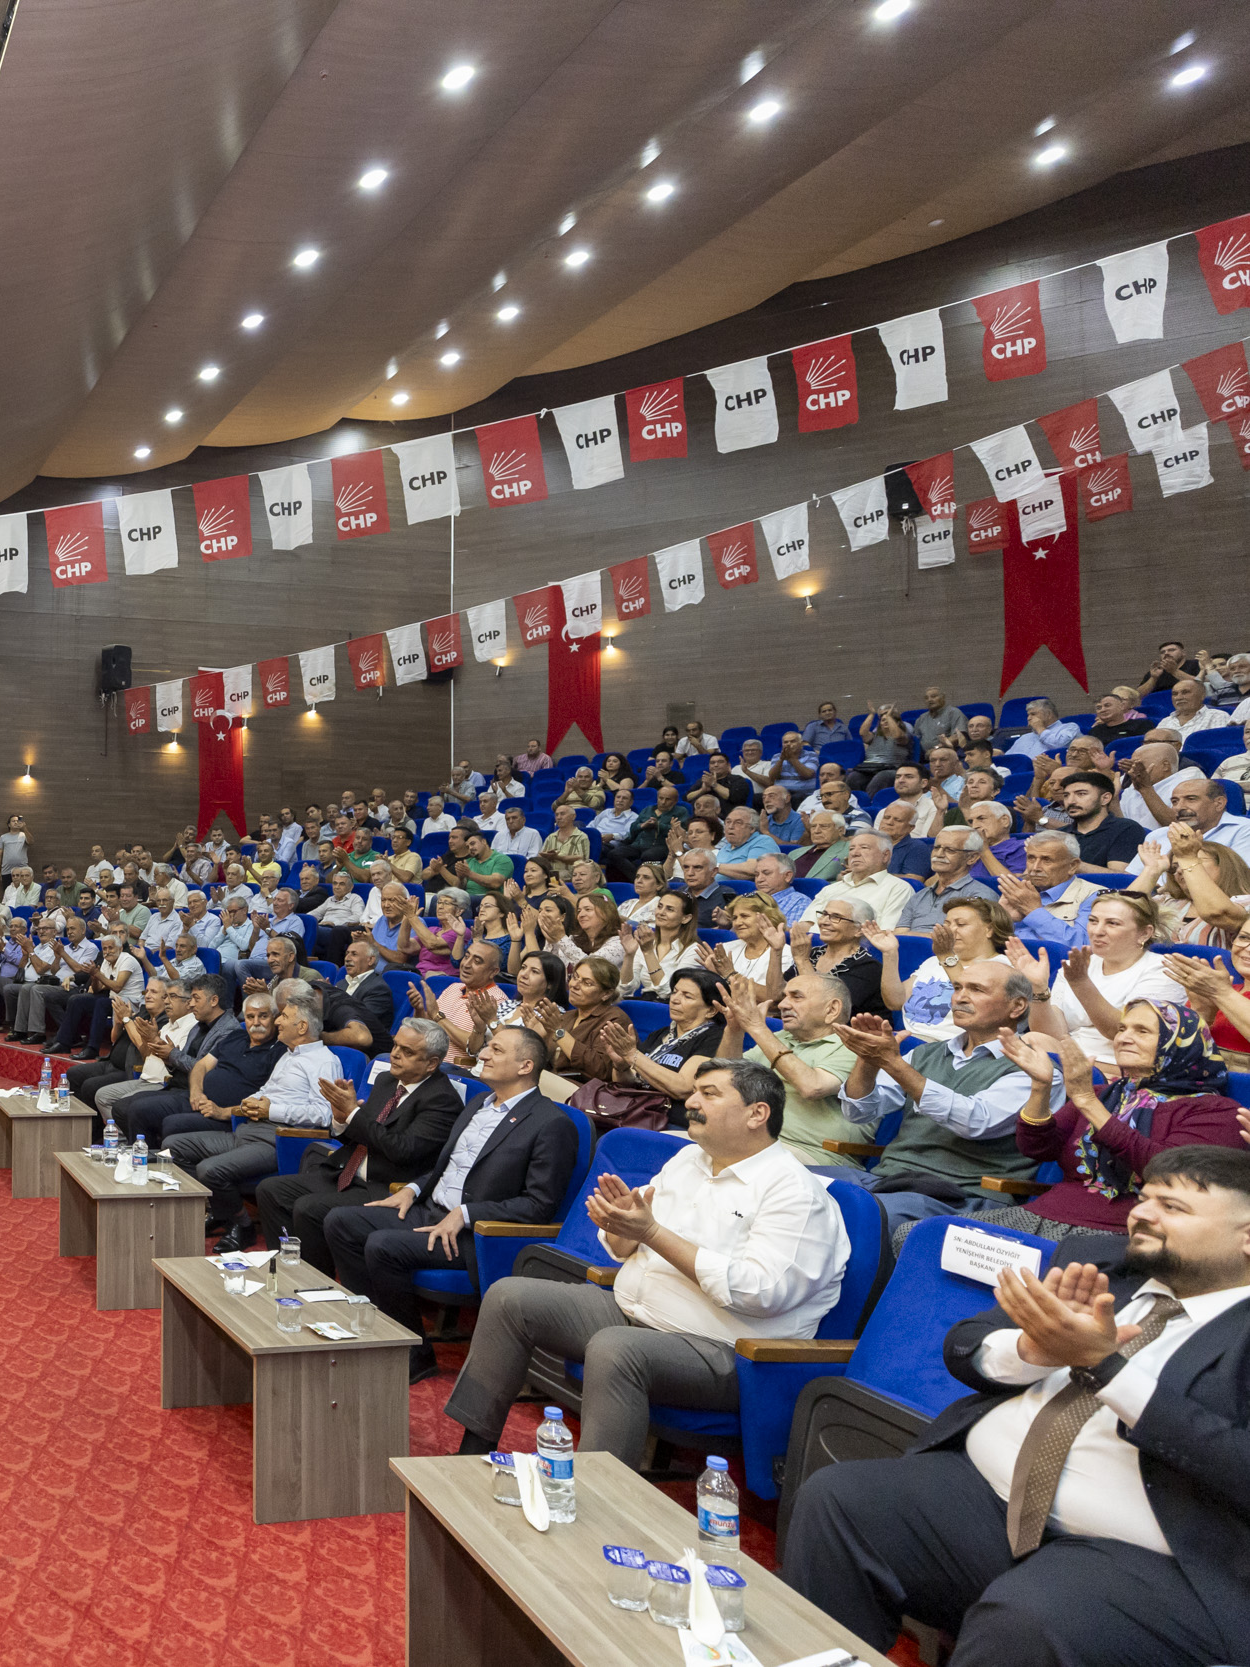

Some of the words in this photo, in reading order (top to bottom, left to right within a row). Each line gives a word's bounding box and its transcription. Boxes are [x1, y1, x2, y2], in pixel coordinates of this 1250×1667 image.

[1222, 268, 1250, 290] CH
[1115, 277, 1157, 301] CHP
[899, 345, 936, 366] CHP
[990, 337, 1037, 360] CHP
[724, 388, 767, 411] CHP
[805, 389, 851, 411] CHP
[1137, 408, 1178, 429] CHP
[575, 428, 612, 450] CHP
[641, 422, 683, 441] CHP
[1074, 450, 1102, 468] CH
[1163, 450, 1200, 468] CHP
[995, 459, 1032, 482] CHP
[408, 470, 448, 491] CHP
[490, 480, 532, 499] CHP
[1090, 487, 1122, 507] CHP
[268, 500, 302, 517] CHP
[1021, 499, 1054, 515] CHP
[337, 512, 378, 532] CHP
[854, 509, 884, 529] CHP
[127, 525, 162, 543] CHP
[922, 529, 951, 544] CHP
[970, 526, 1001, 542] CHP
[199, 535, 238, 555] CHP
[776, 539, 805, 557] CHP
[55, 561, 92, 580] CHP
[724, 564, 751, 581] CHP
[668, 573, 696, 590] CHP
[571, 603, 597, 618] CHP
[621, 597, 645, 613] CHP
[477, 630, 500, 644] CHP
[526, 625, 551, 641] CHP
[397, 653, 420, 667] CHP
[434, 651, 457, 666] CHP
[309, 674, 329, 686] CHP
[360, 670, 380, 684] CHP
[230, 690, 249, 702] CHP
[267, 691, 287, 704] CHP
[161, 706, 179, 717] CHP
[193, 707, 214, 718] CHP
[964, 1239, 995, 1252] ABDULLAH
